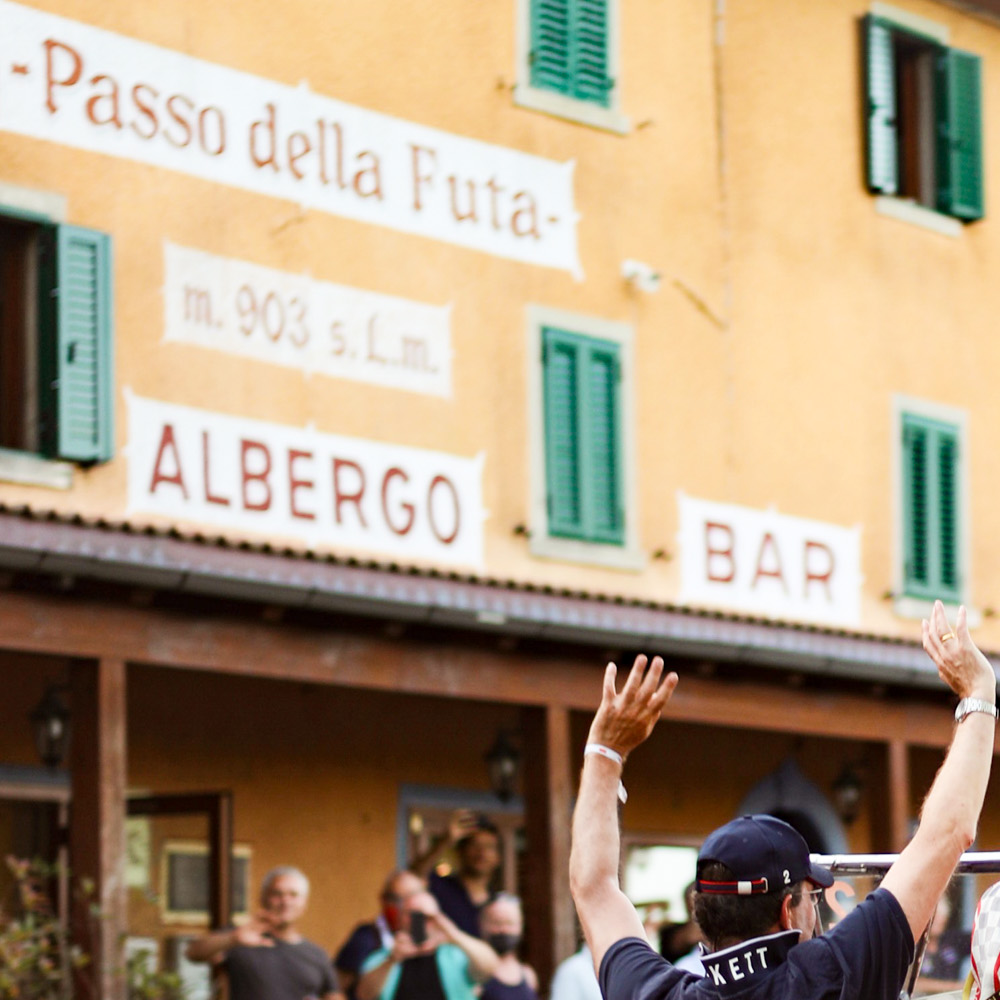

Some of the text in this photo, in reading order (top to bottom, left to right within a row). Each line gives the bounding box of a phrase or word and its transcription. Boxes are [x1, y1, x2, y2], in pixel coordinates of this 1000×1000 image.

[250, 102, 383, 201] della
[184, 284, 223, 328] m.
[236, 283, 309, 349] 903
[149, 423, 460, 544] ALBERGO
[705, 521, 835, 602] BAR
[783, 869, 791, 885] 2
[707, 946, 768, 986] KETT
